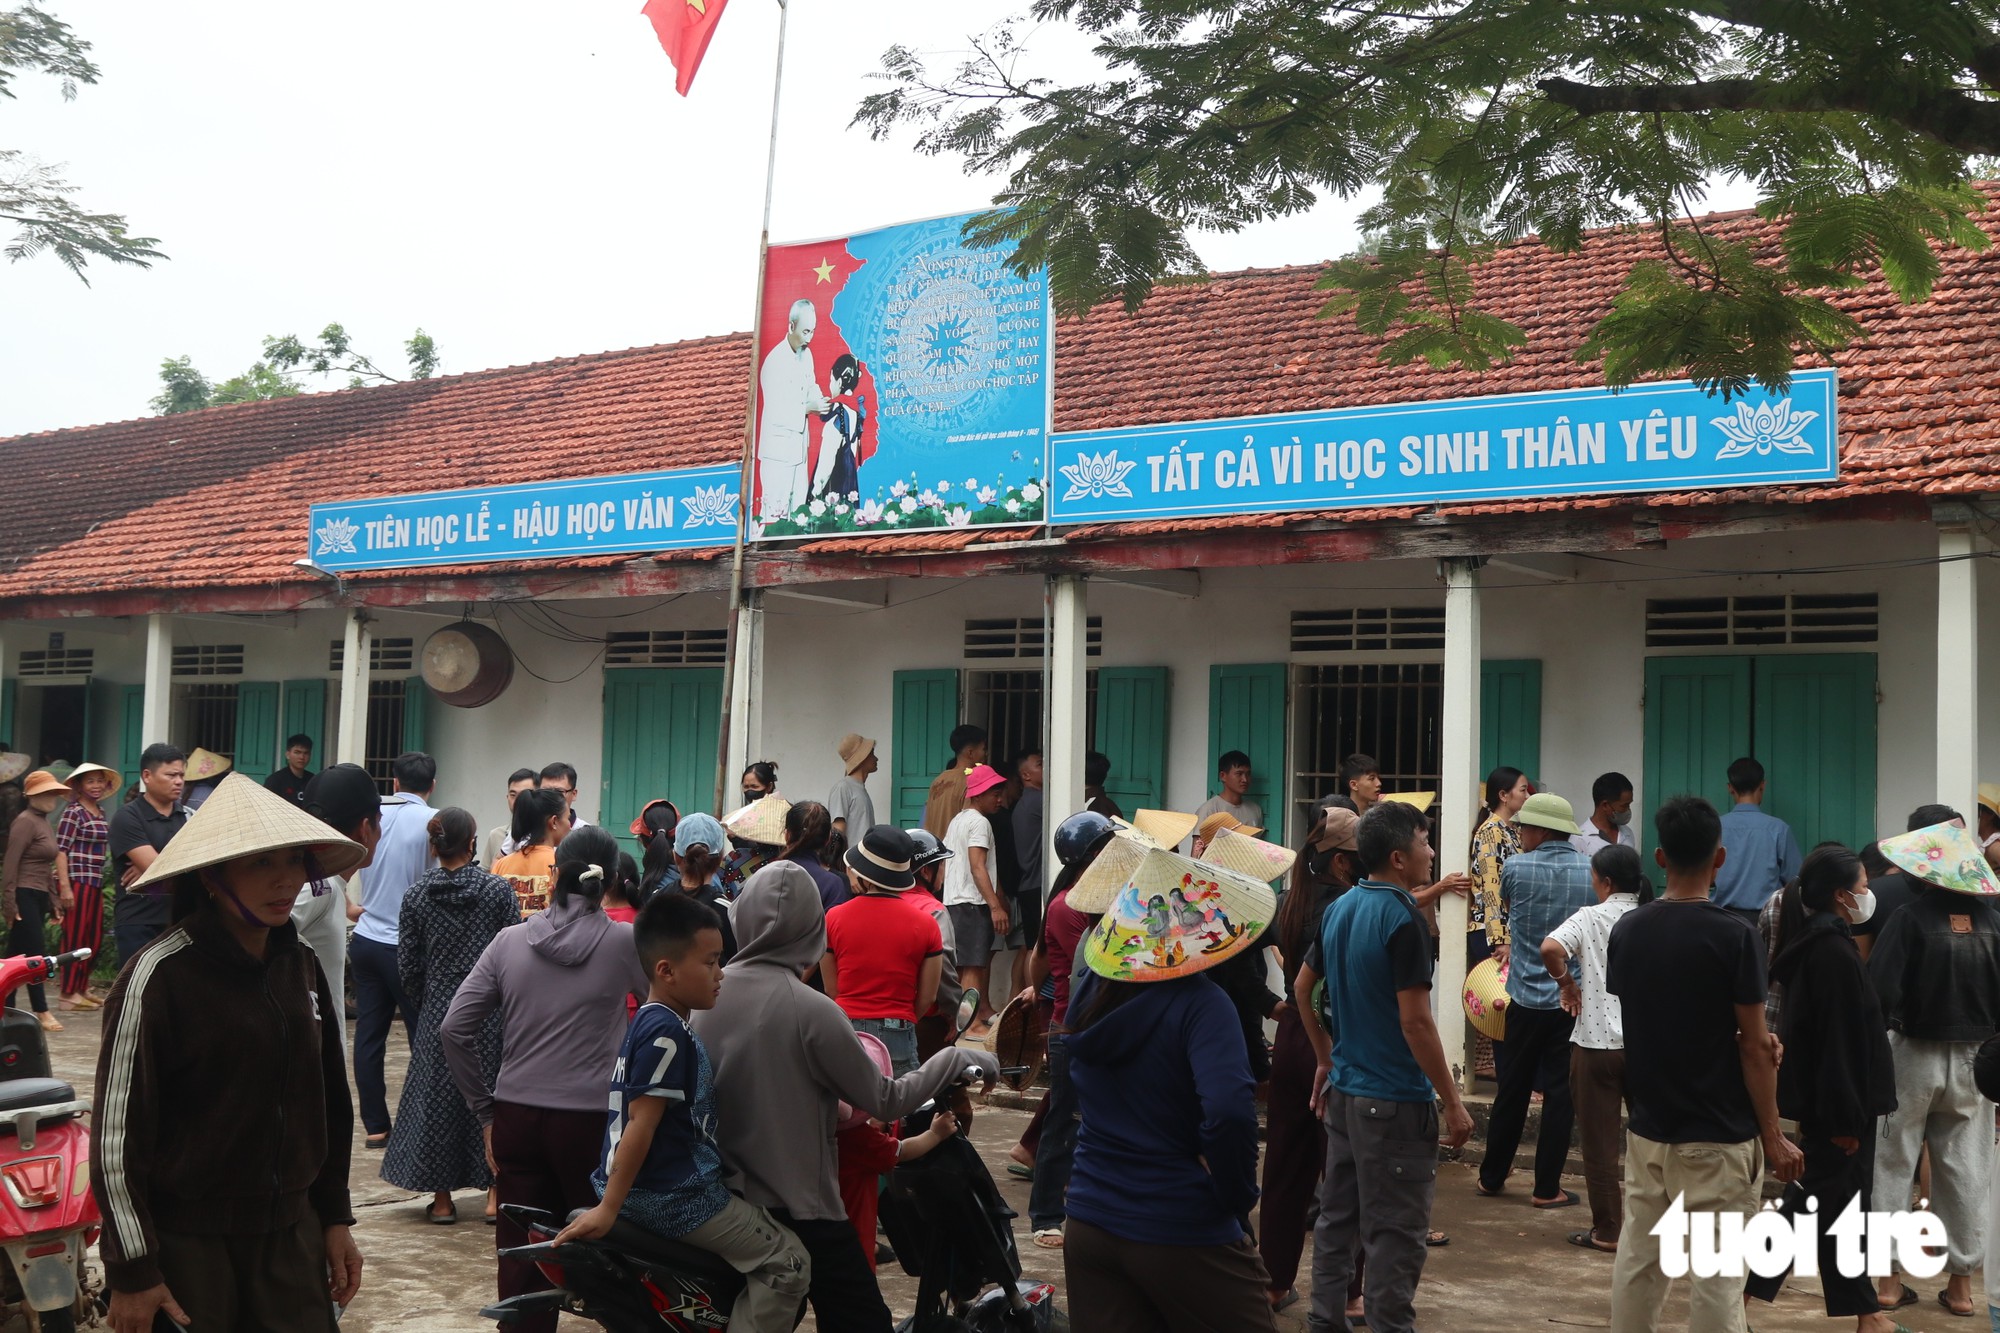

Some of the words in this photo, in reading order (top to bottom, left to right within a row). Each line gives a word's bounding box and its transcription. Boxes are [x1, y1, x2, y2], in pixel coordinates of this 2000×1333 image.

[974, 250, 999, 265] VIỆT
[985, 267, 1010, 282] ĐẸP
[973, 285, 998, 300] VIỆT
[1000, 284, 1023, 297] NAM
[1025, 279, 1041, 293] CÓ
[985, 302, 1022, 317] QUANG
[1025, 294, 1041, 311] ĐỂ
[920, 330, 939, 343] VAI
[945, 325, 965, 339] VỚI
[998, 317, 1040, 333] CƯỜNG
[1018, 336, 1039, 349] HAY
[1016, 352, 1039, 368] MỘT
[961, 377, 990, 390] CÔNG
[993, 375, 1016, 389] HỌC
[1017, 370, 1039, 387] TẬP
[884, 402, 905, 417] CỦA
[906, 400, 927, 415] CÁC
[1147, 439, 1204, 494] TẤT
[1215, 435, 1260, 489] CẢ
[1271, 425, 1304, 486] VÌ
[1315, 437, 1387, 490] HỌC
[1398, 430, 1490, 478] SINH
[1502, 414, 1607, 469] THÂN
[1619, 408, 1699, 463] YÊU
[365, 513, 411, 550] TIÊN
[416, 513, 458, 552] HỌC
[465, 500, 491, 543] LỄ
[497, 523, 506, 531] -
[513, 500, 559, 545] HẬU
[566, 501, 616, 541] HỌC
[623, 491, 675, 532] VĂN
[648, 1036, 677, 1085] 7
